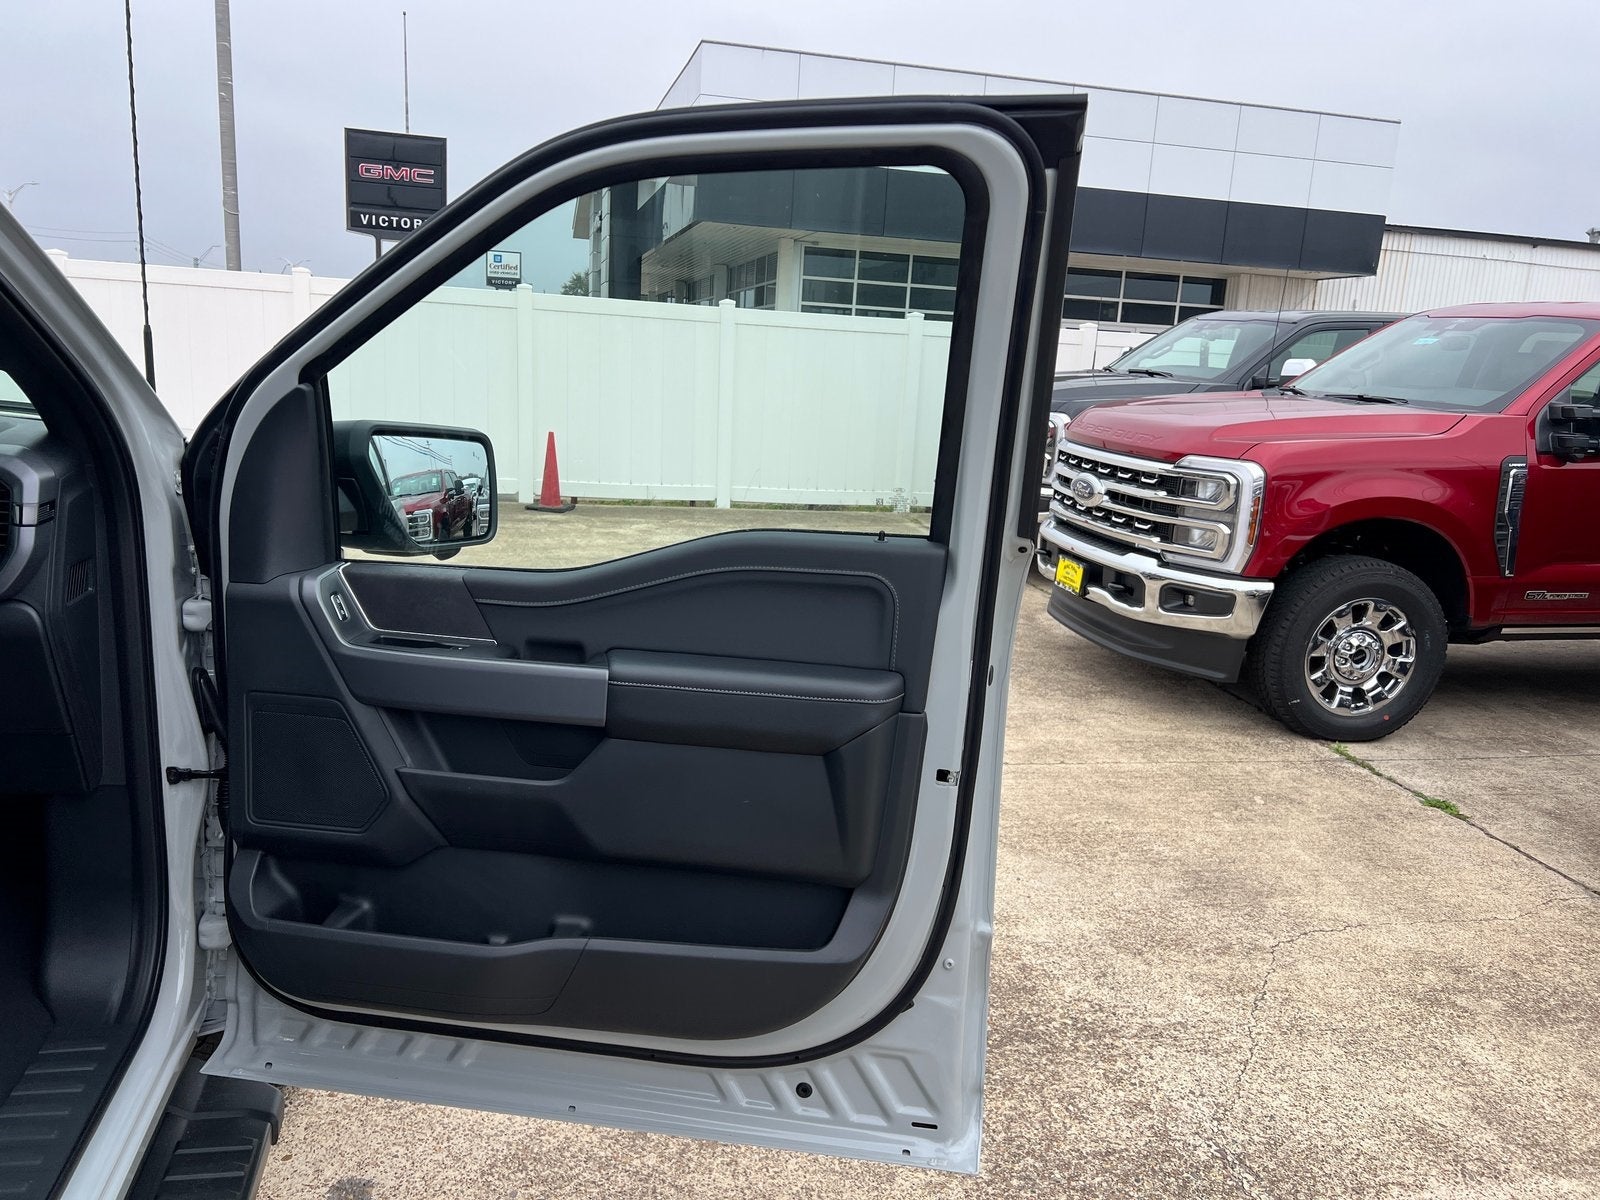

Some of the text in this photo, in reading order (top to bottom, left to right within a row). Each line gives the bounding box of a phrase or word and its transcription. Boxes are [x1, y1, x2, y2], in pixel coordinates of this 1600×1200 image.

[358, 163, 435, 184] GMC
[360, 213, 428, 229] VICTOR
[489, 263, 519, 272] Certified
